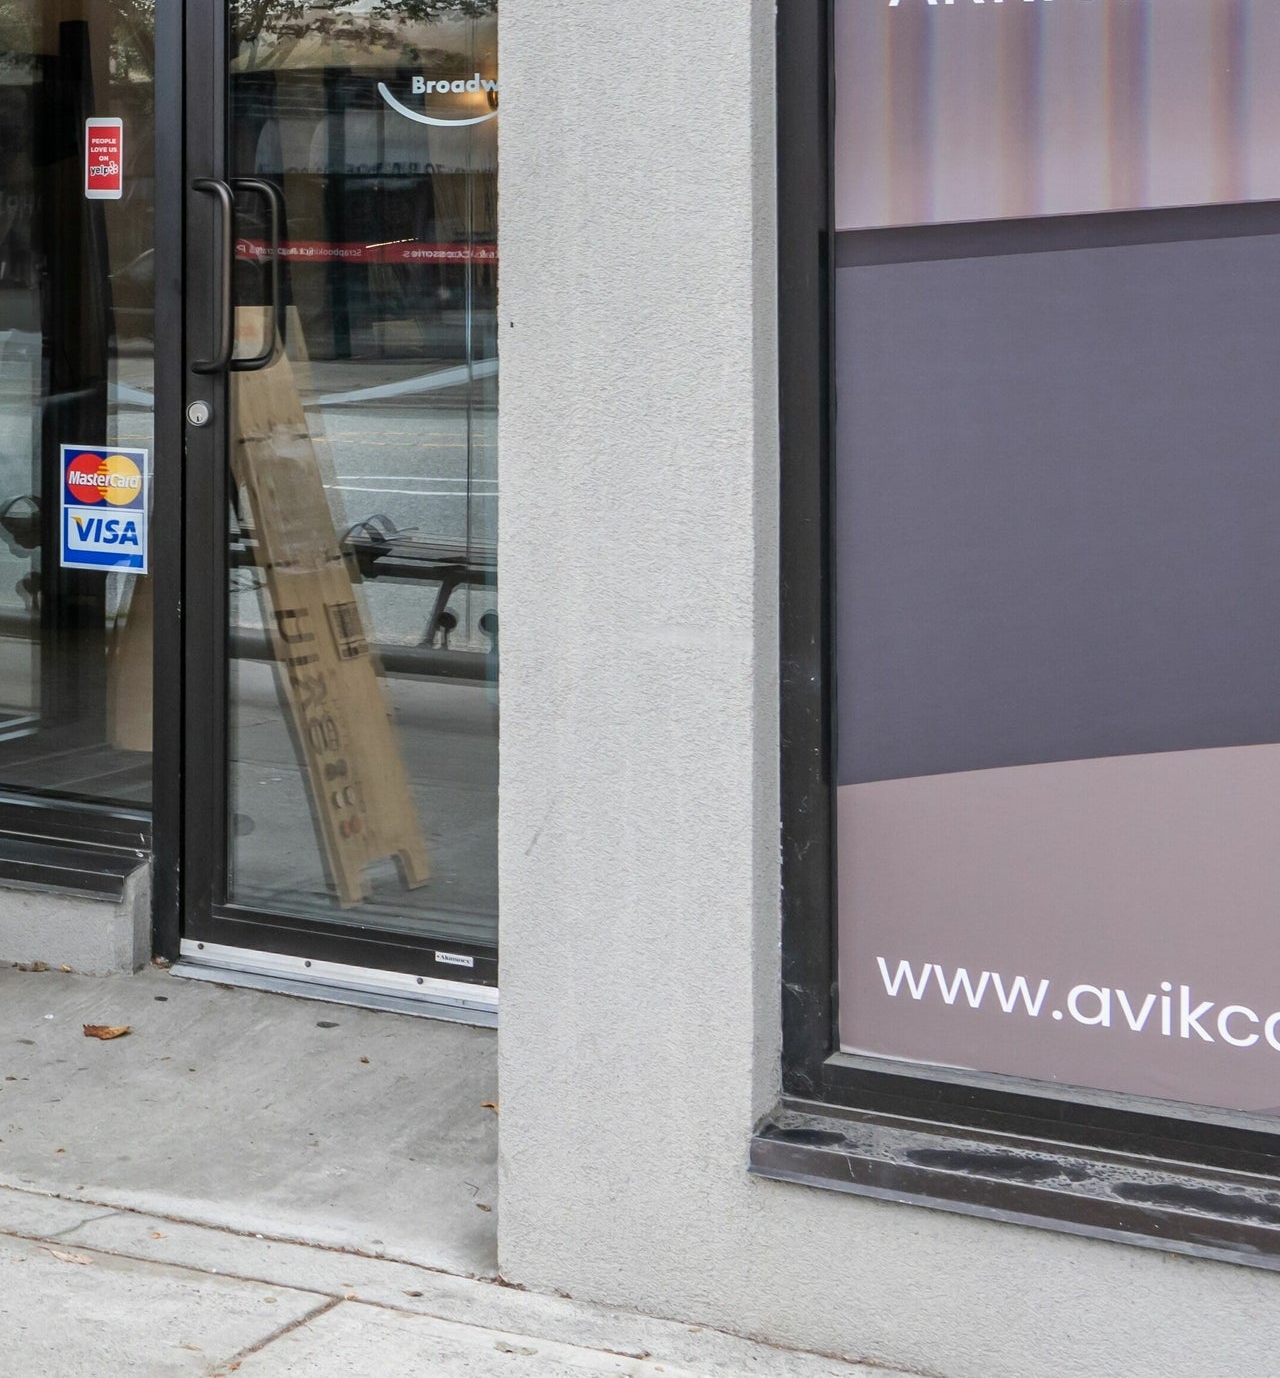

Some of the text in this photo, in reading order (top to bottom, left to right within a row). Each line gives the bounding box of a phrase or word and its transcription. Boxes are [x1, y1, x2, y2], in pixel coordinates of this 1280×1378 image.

[412, 73, 498, 95] Broadw
[90, 166, 110, 176] yelp
[68, 470, 139, 489] MasterCard
[71, 517, 139, 546] VISA
